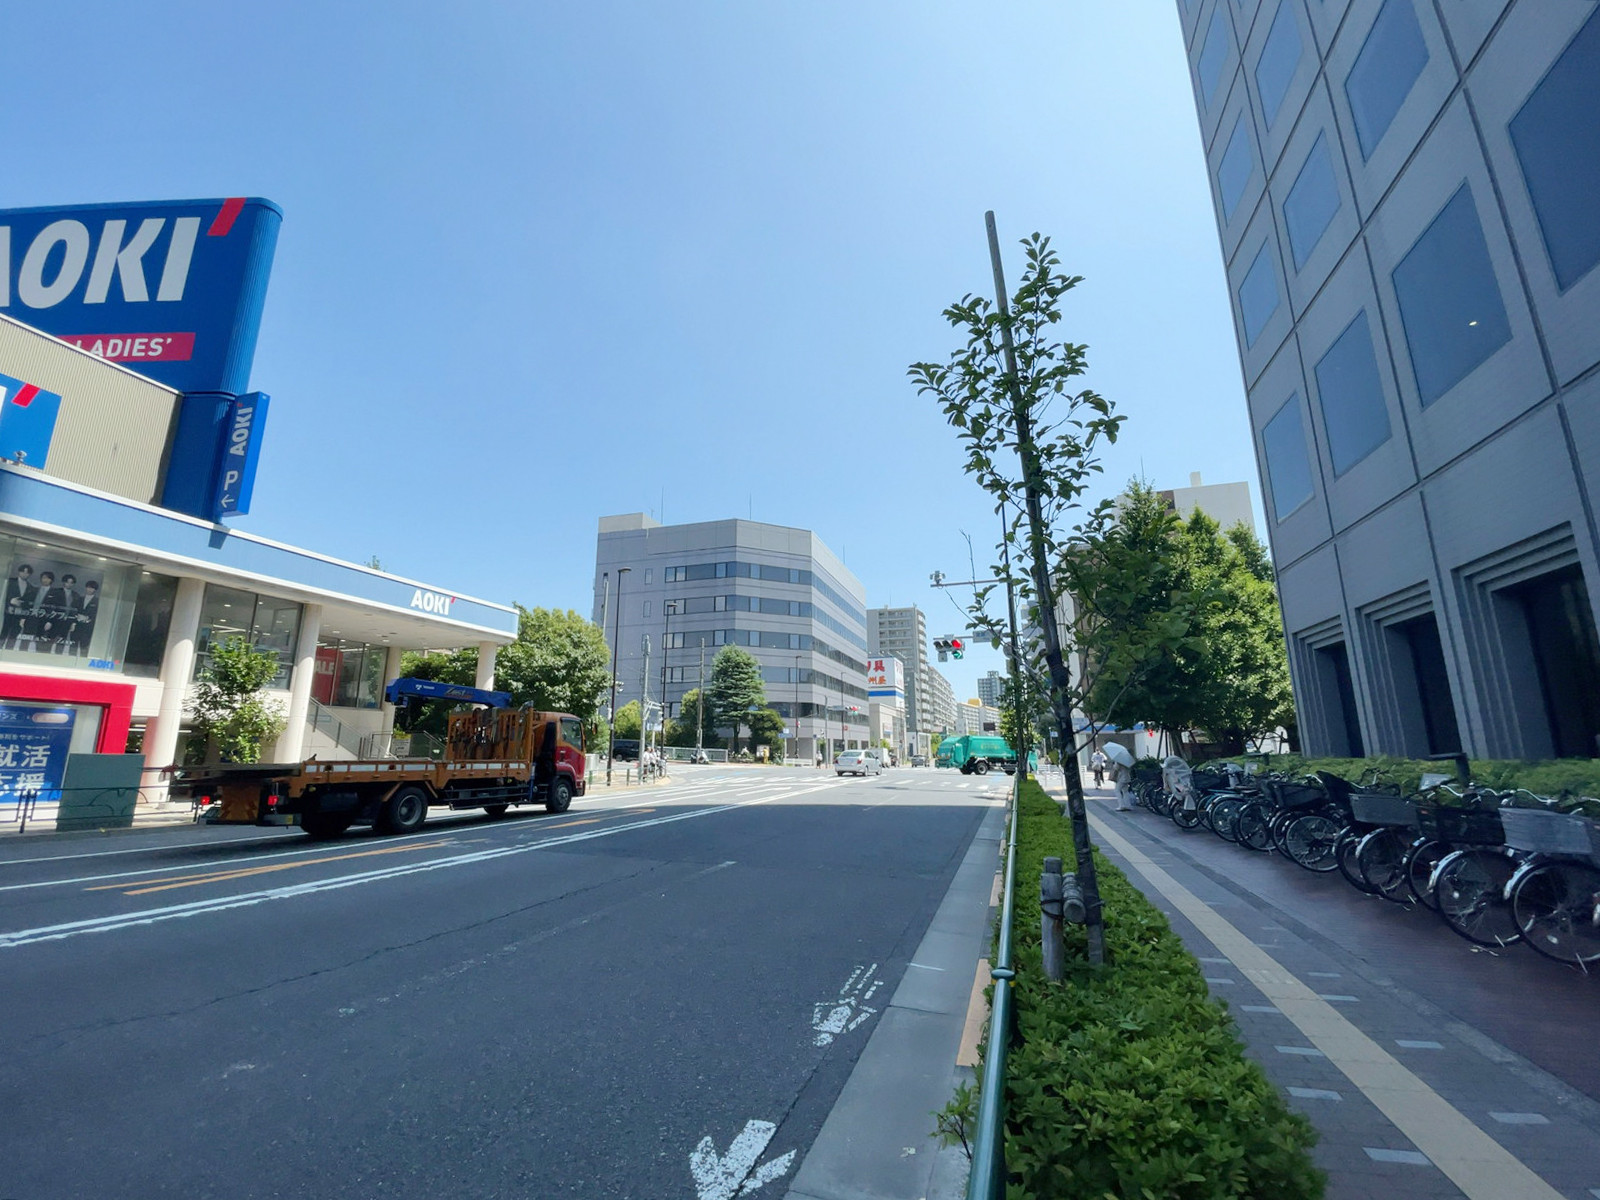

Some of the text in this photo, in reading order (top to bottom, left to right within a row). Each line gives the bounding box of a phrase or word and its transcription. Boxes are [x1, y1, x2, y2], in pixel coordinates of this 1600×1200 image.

[0, 216, 200, 309] OKI
[229, 407, 253, 456] AOKI
[224, 470, 239, 491] P
[410, 589, 450, 616] AOKI
[0, 744, 51, 768] 就活
